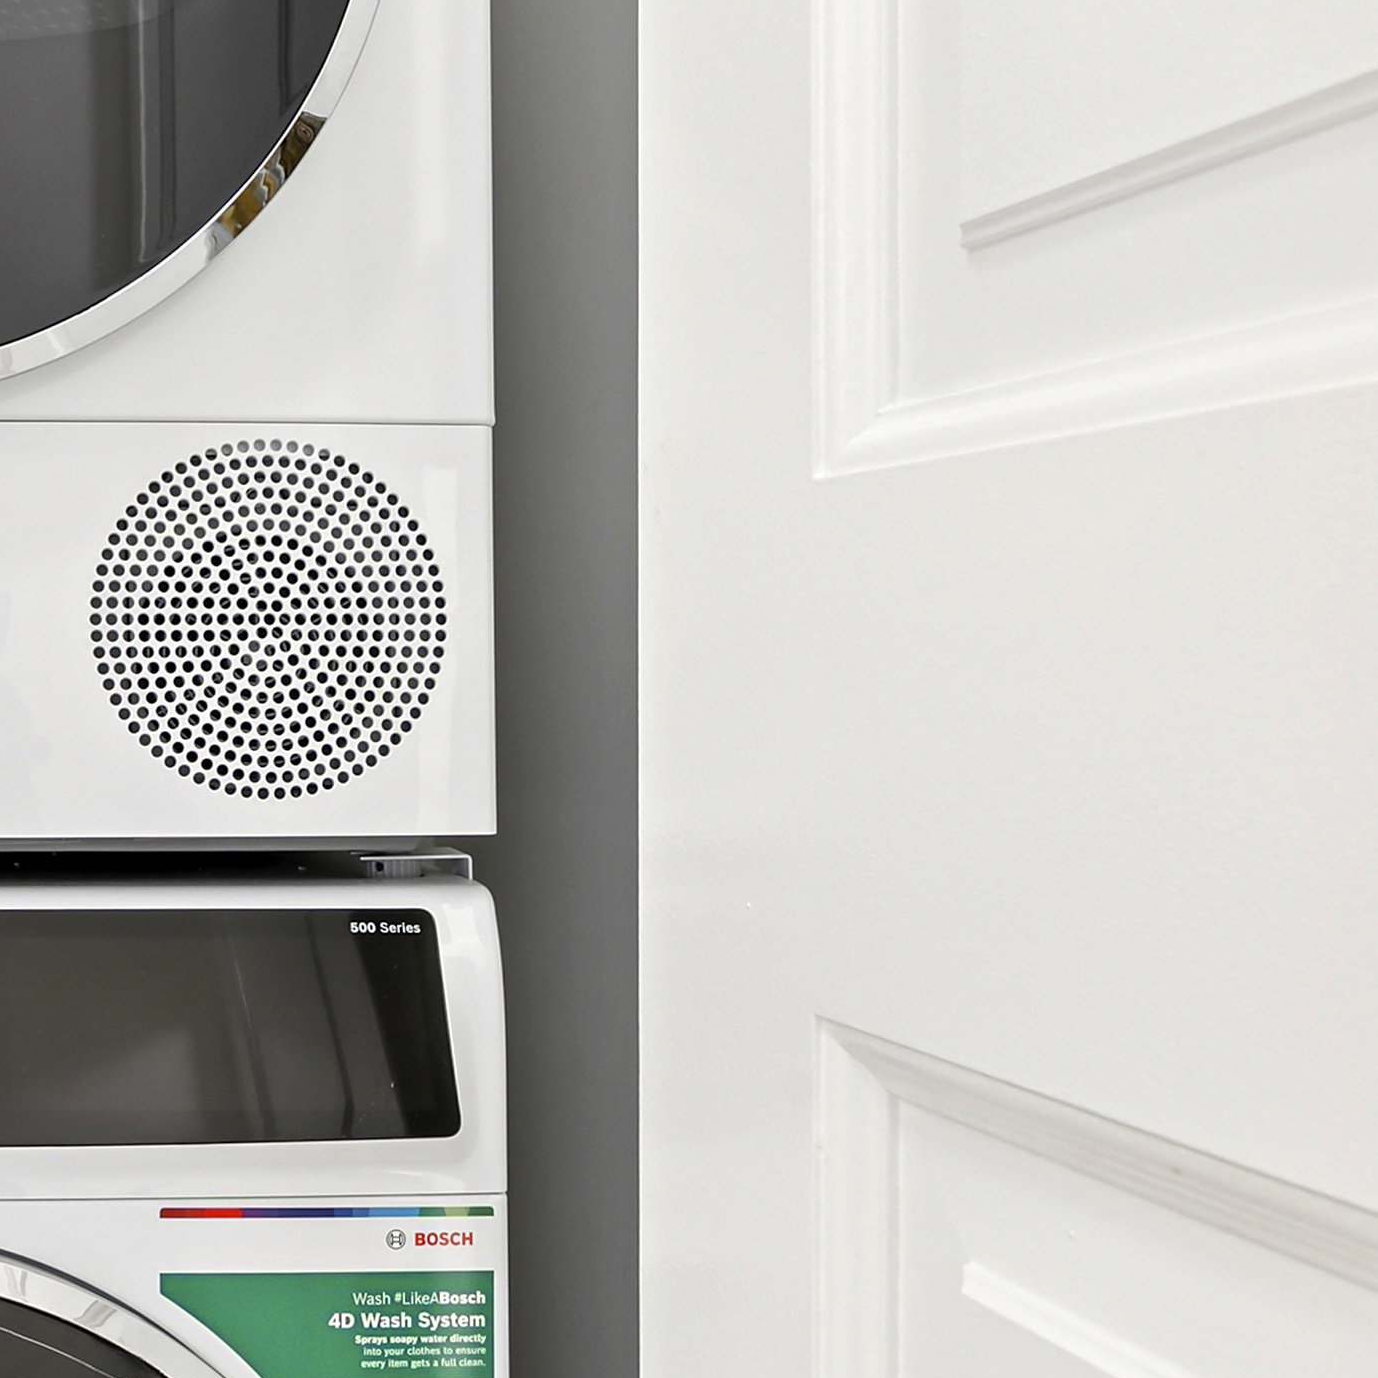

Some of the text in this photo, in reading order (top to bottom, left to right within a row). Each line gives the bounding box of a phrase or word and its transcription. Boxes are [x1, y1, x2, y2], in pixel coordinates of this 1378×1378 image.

[350, 922, 421, 933] 500 Series
[415, 1232, 473, 1246] BOSCH
[353, 1291, 486, 1305] Wash #LikeABosch
[328, 1312, 485, 1330] 4D Wash System
[355, 1334, 486, 1345] Sprays soapy water directly
[364, 1346, 486, 1357] into your clothes to ensure
[361, 1361, 388, 1369] every
[388, 1359, 408, 1368] item
[409, 1359, 431, 1369] gets
[441, 1358, 458, 1367] full
[457, 1358, 486, 1367] clean.
